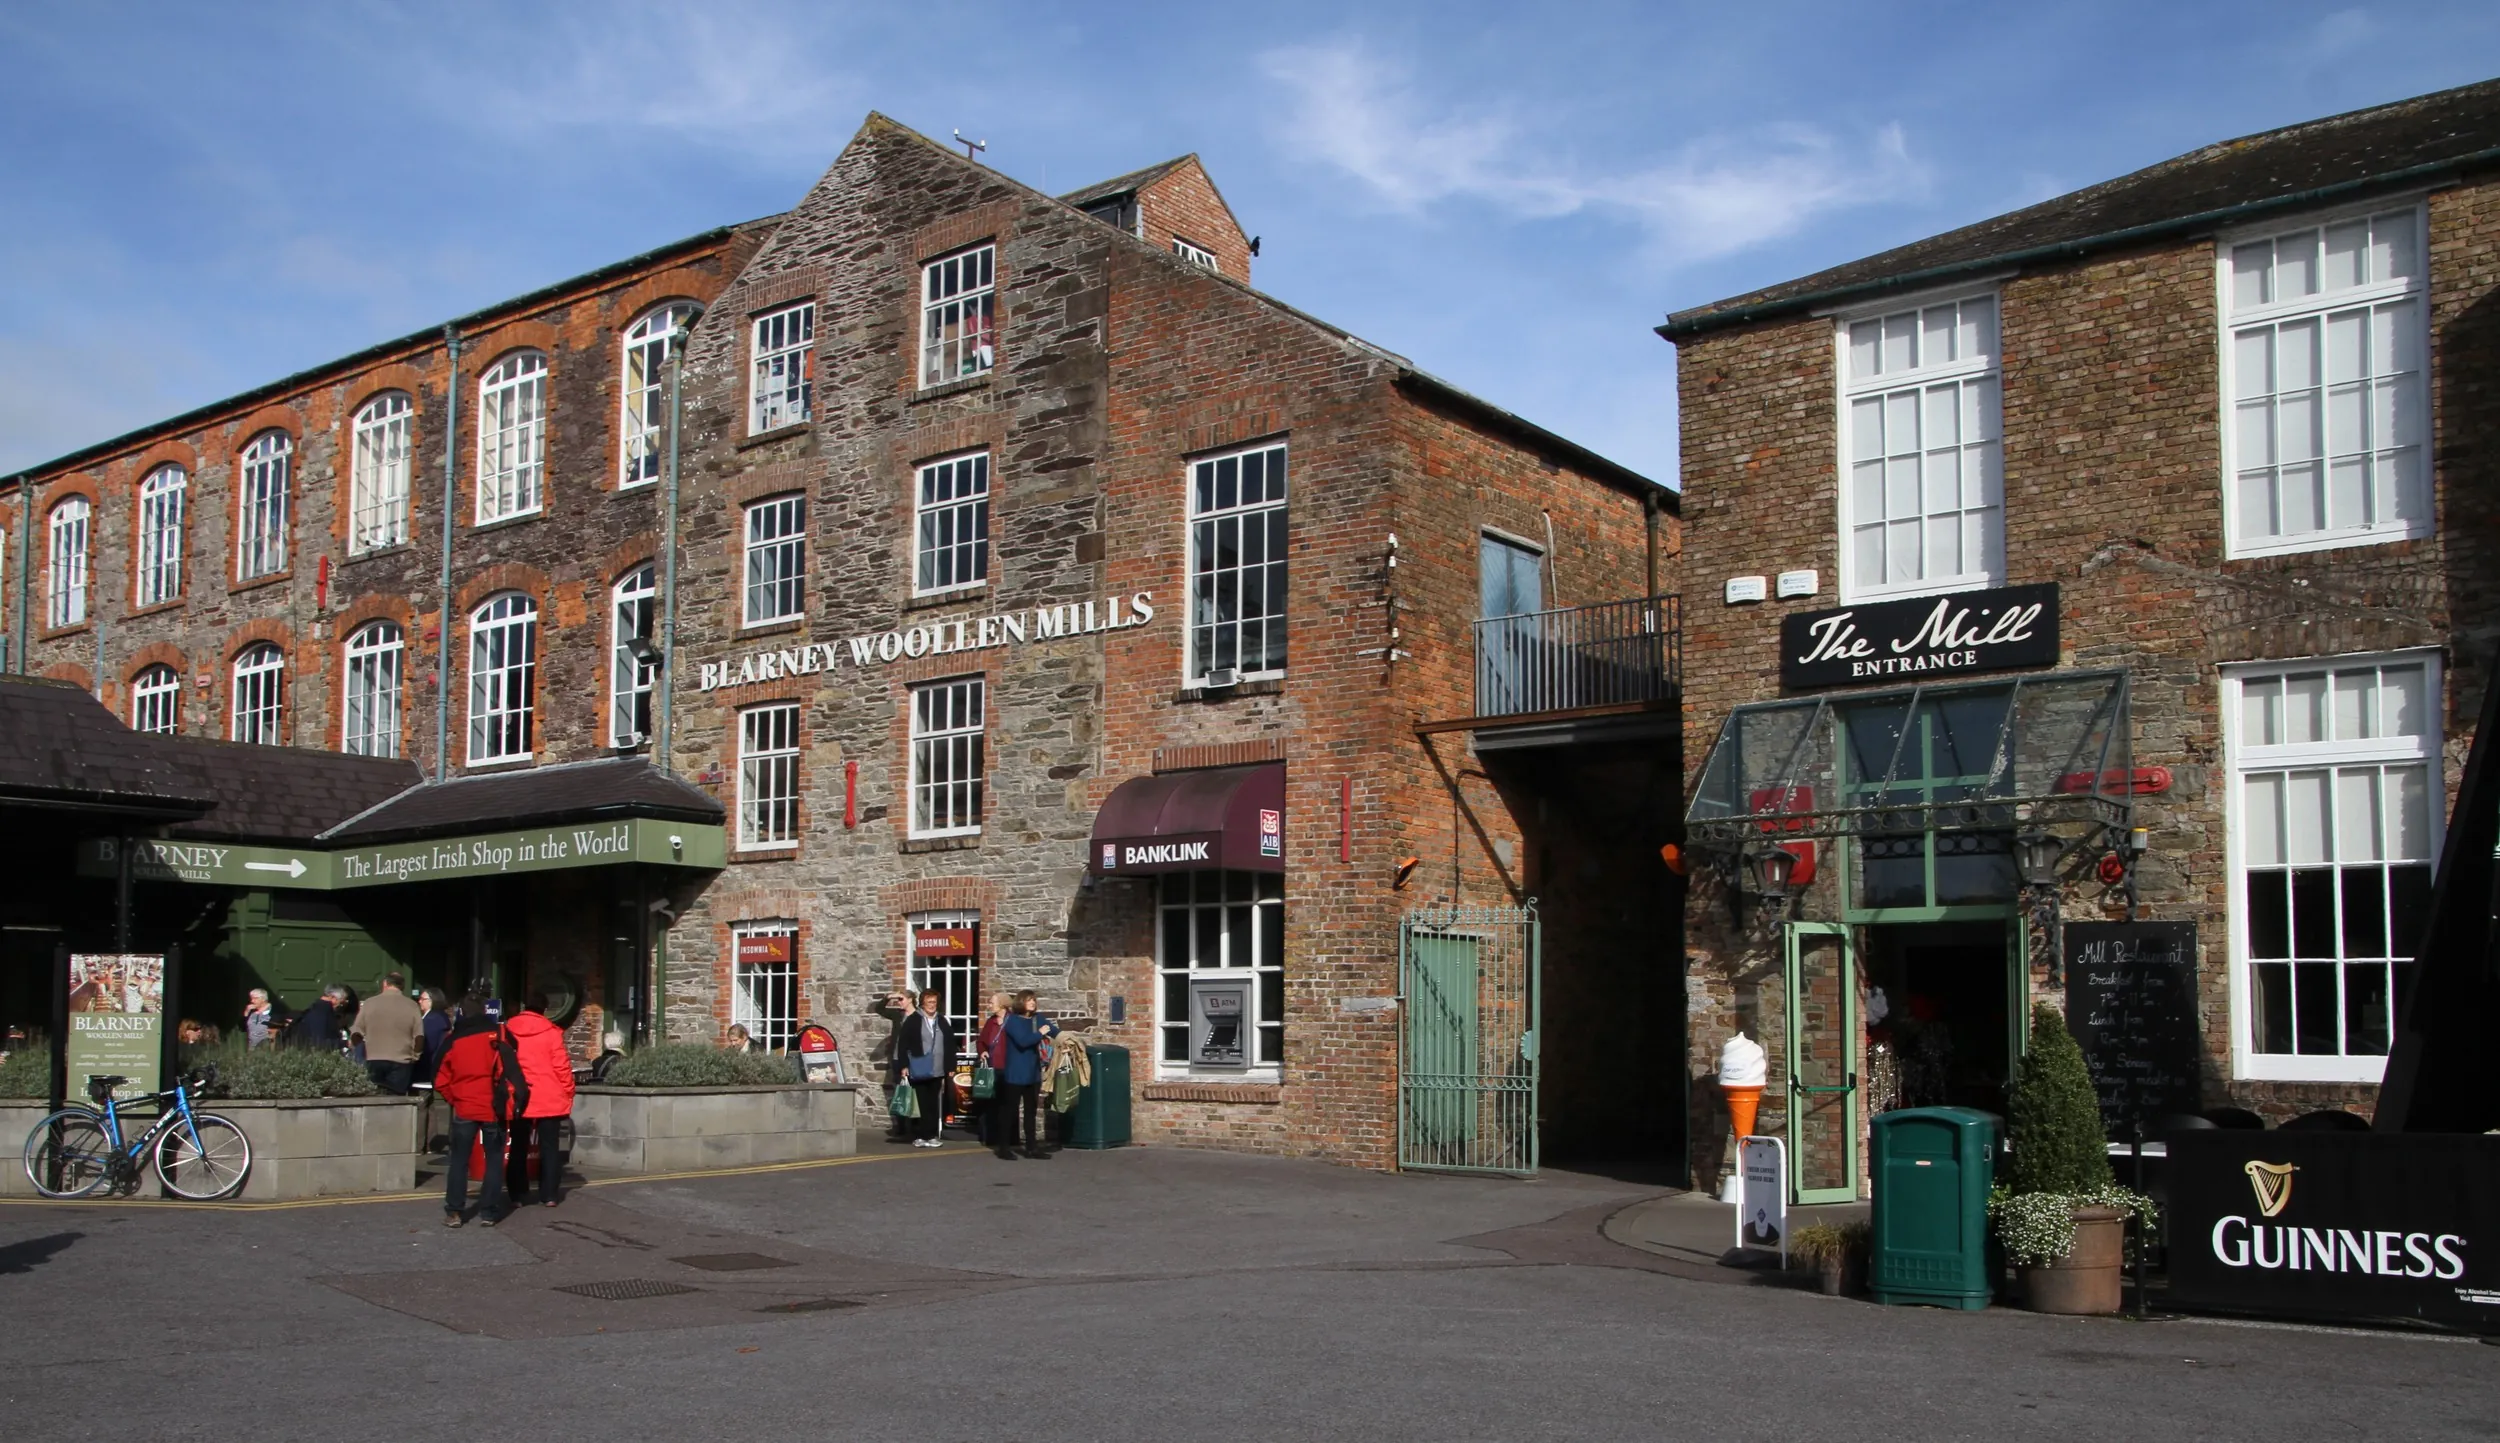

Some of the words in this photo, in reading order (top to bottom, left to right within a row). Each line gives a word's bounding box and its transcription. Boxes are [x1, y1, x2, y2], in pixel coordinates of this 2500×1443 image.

[700, 641, 838, 692] BLARNEY
[849, 612, 1028, 666] WOOLLEN
[1034, 591, 1155, 640] MILLS
[1798, 611, 1876, 665] The
[1891, 598, 2043, 655] Mill
[1852, 650, 1977, 677] ENTRANCE
[344, 857, 370, 878] The
[375, 853, 427, 880] Largest
[433, 845, 467, 869] Irish
[472, 840, 512, 871] Shop
[519, 838, 535, 862] in
[541, 834, 567, 860] the
[573, 825, 629, 855] World
[1262, 835, 1278, 848] AIB
[98, 840, 229, 868] BARNEY
[1125, 842, 1209, 865] BANKLINK
[179, 870, 211, 879] MILLS
[740, 945, 768, 954] INSOMNIA
[917, 938, 949, 947] INSOMNIA
[75, 1016, 156, 1031] BLARNEY
[112, 1088, 131, 1099] hop
[2212, 1215, 2465, 1280] GUINNESS
